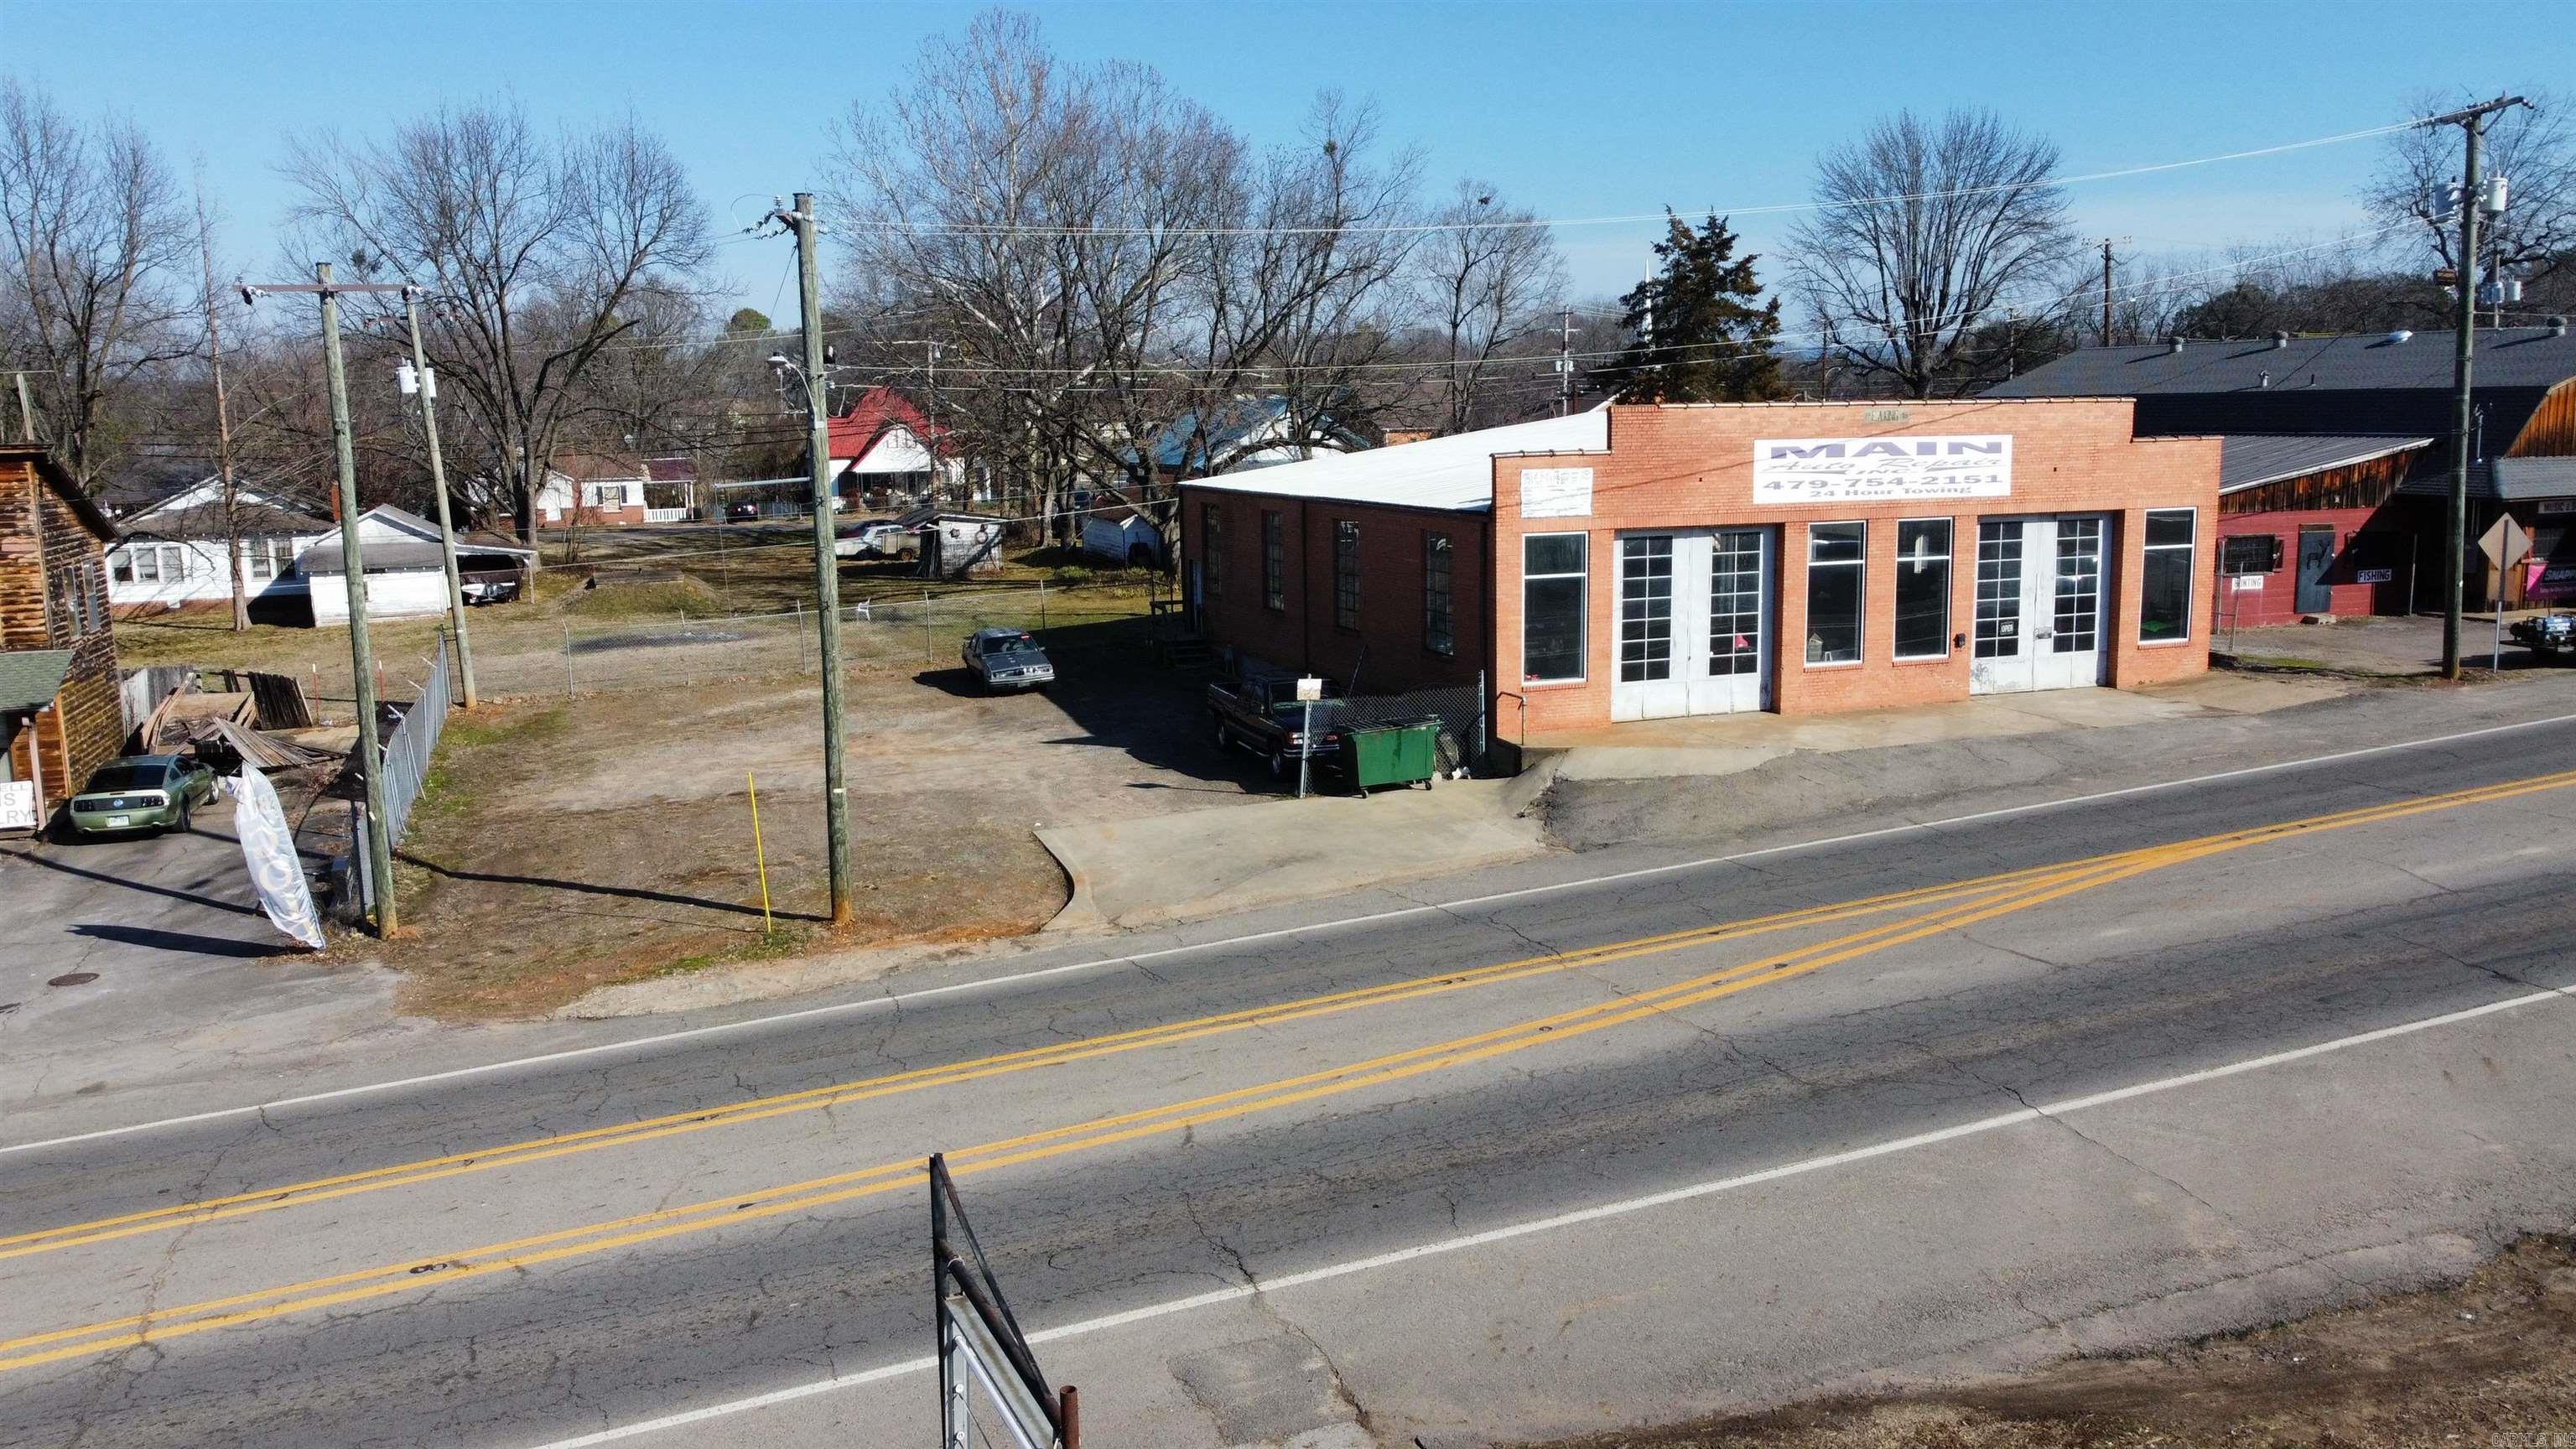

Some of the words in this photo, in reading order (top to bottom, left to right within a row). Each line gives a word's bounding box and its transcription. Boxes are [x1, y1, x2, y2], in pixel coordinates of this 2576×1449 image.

[1771, 442, 2002, 459] MAIN
[1763, 461, 1855, 470] Auto
[1875, 458, 2001, 470] Repair
[1763, 475, 2002, 490] 479-754-2151
[1903, 486, 1971, 495] Towing
[2359, 570, 2390, 581] FISHING
[2001, 624, 2012, 632] OPEN
